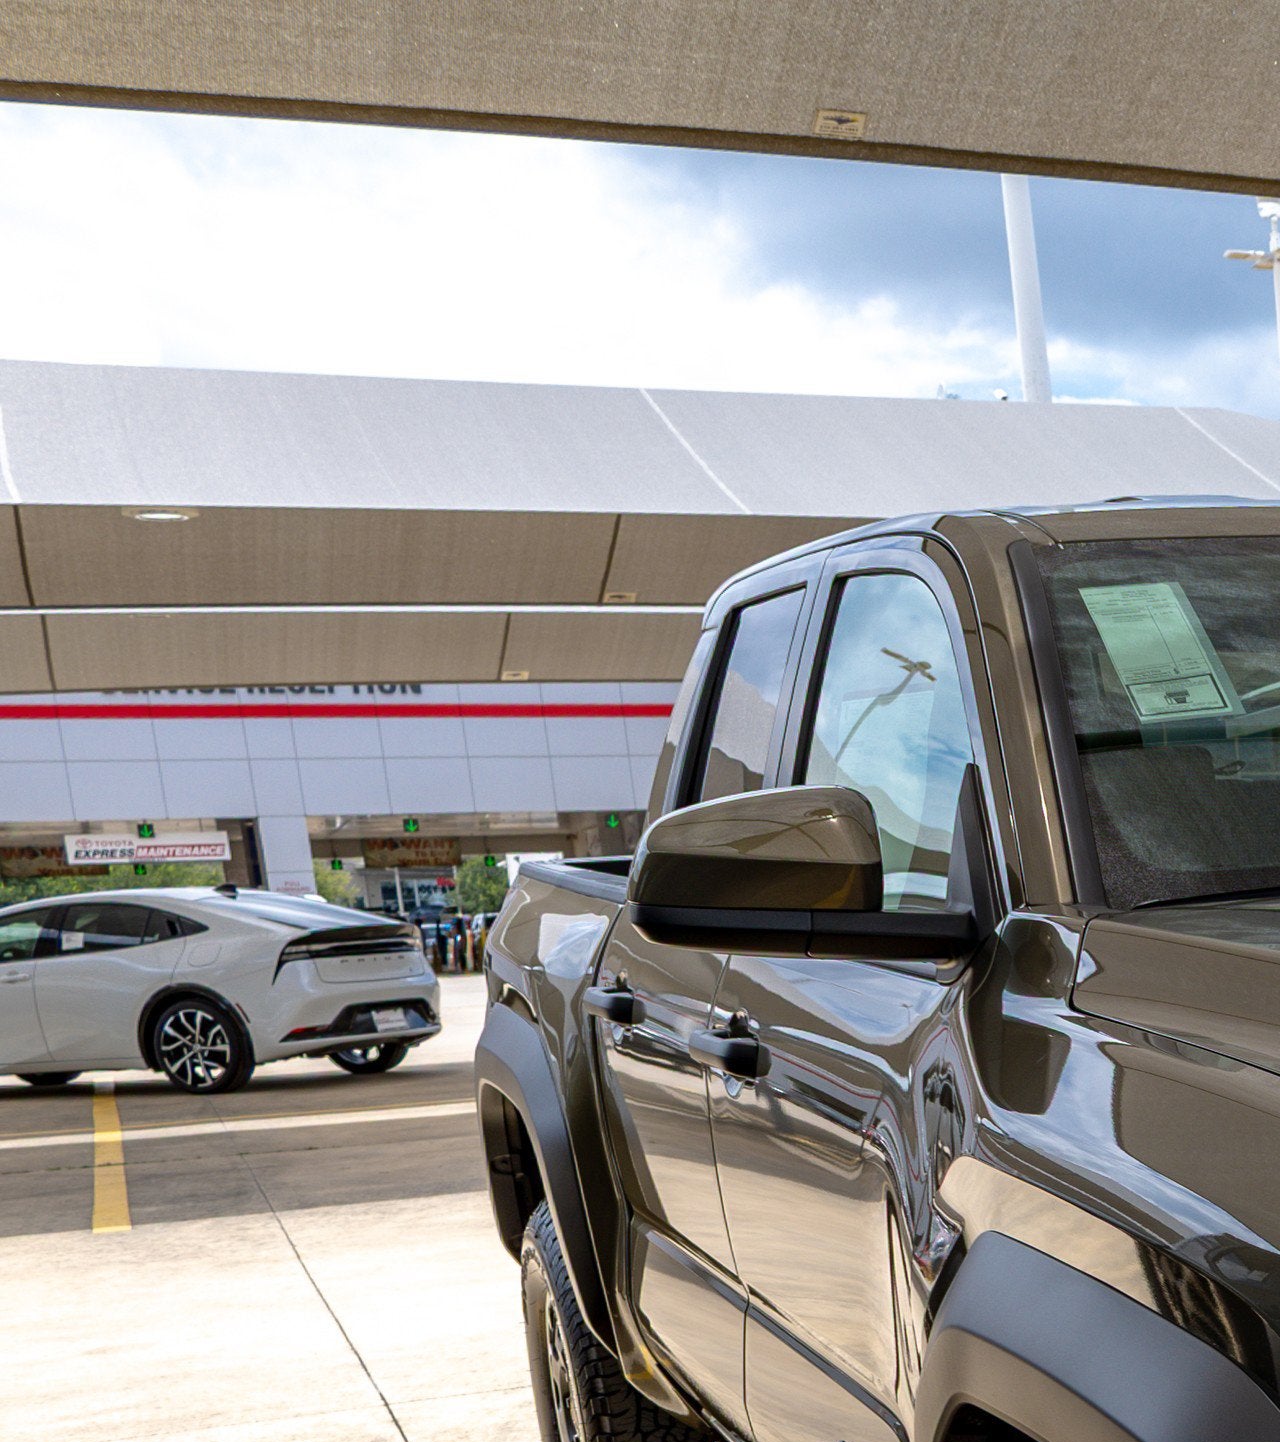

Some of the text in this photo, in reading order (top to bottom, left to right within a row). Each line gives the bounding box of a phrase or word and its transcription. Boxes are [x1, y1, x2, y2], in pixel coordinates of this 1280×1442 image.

[93, 839, 134, 847] TOYOTA
[74, 848, 135, 860] EXPRESS
[135, 844, 225, 858] MAINTENANCE
